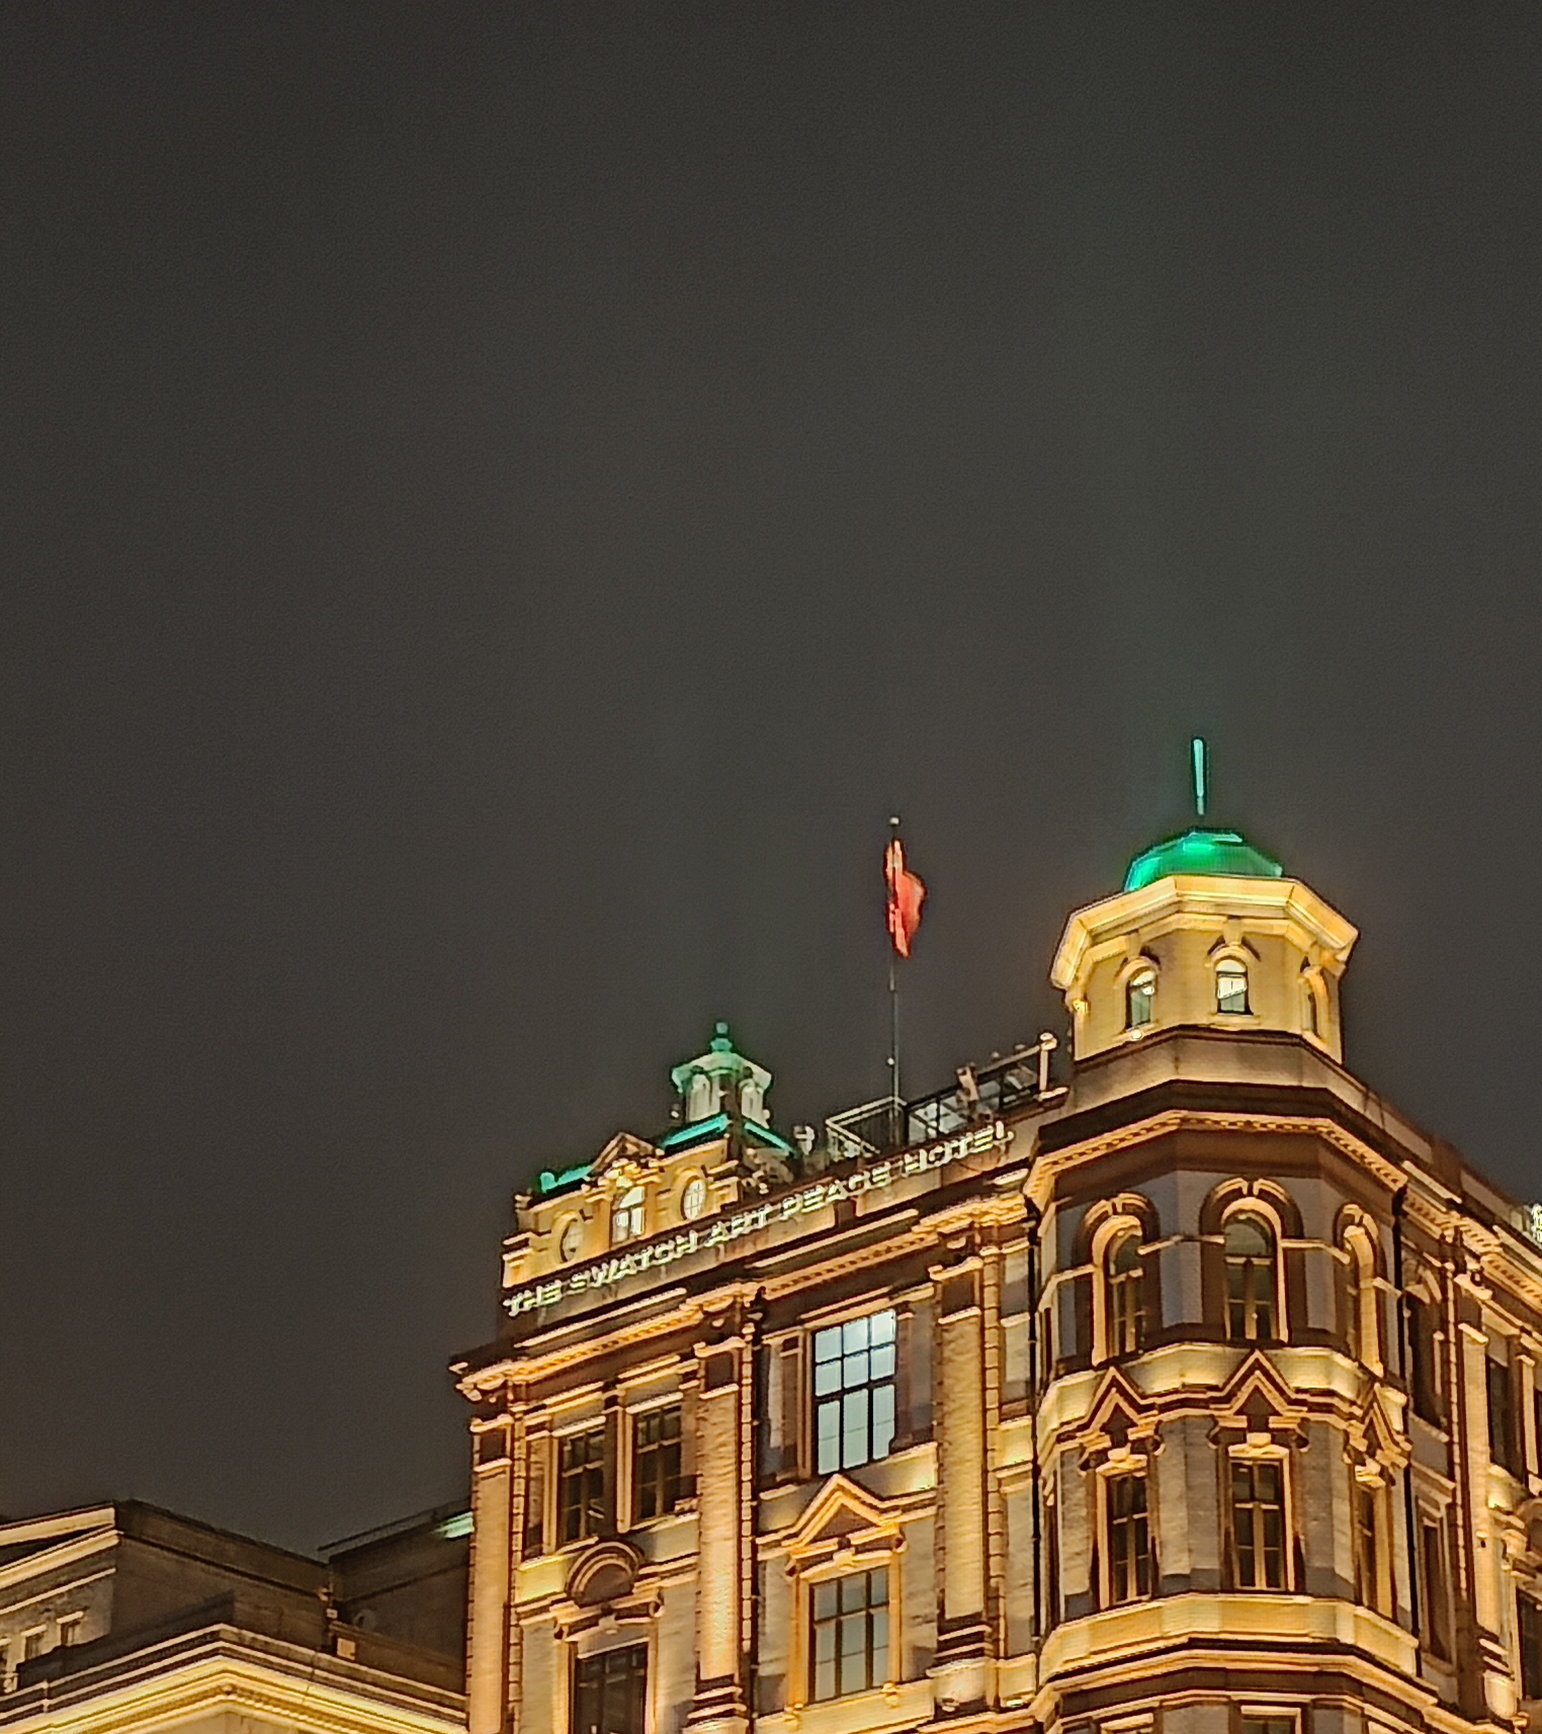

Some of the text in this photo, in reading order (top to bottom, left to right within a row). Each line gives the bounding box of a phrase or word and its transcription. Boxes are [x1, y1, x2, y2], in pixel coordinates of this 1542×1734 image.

[503, 1121, 1015, 1317] THE SWATCH ART PEACE HOTEL
